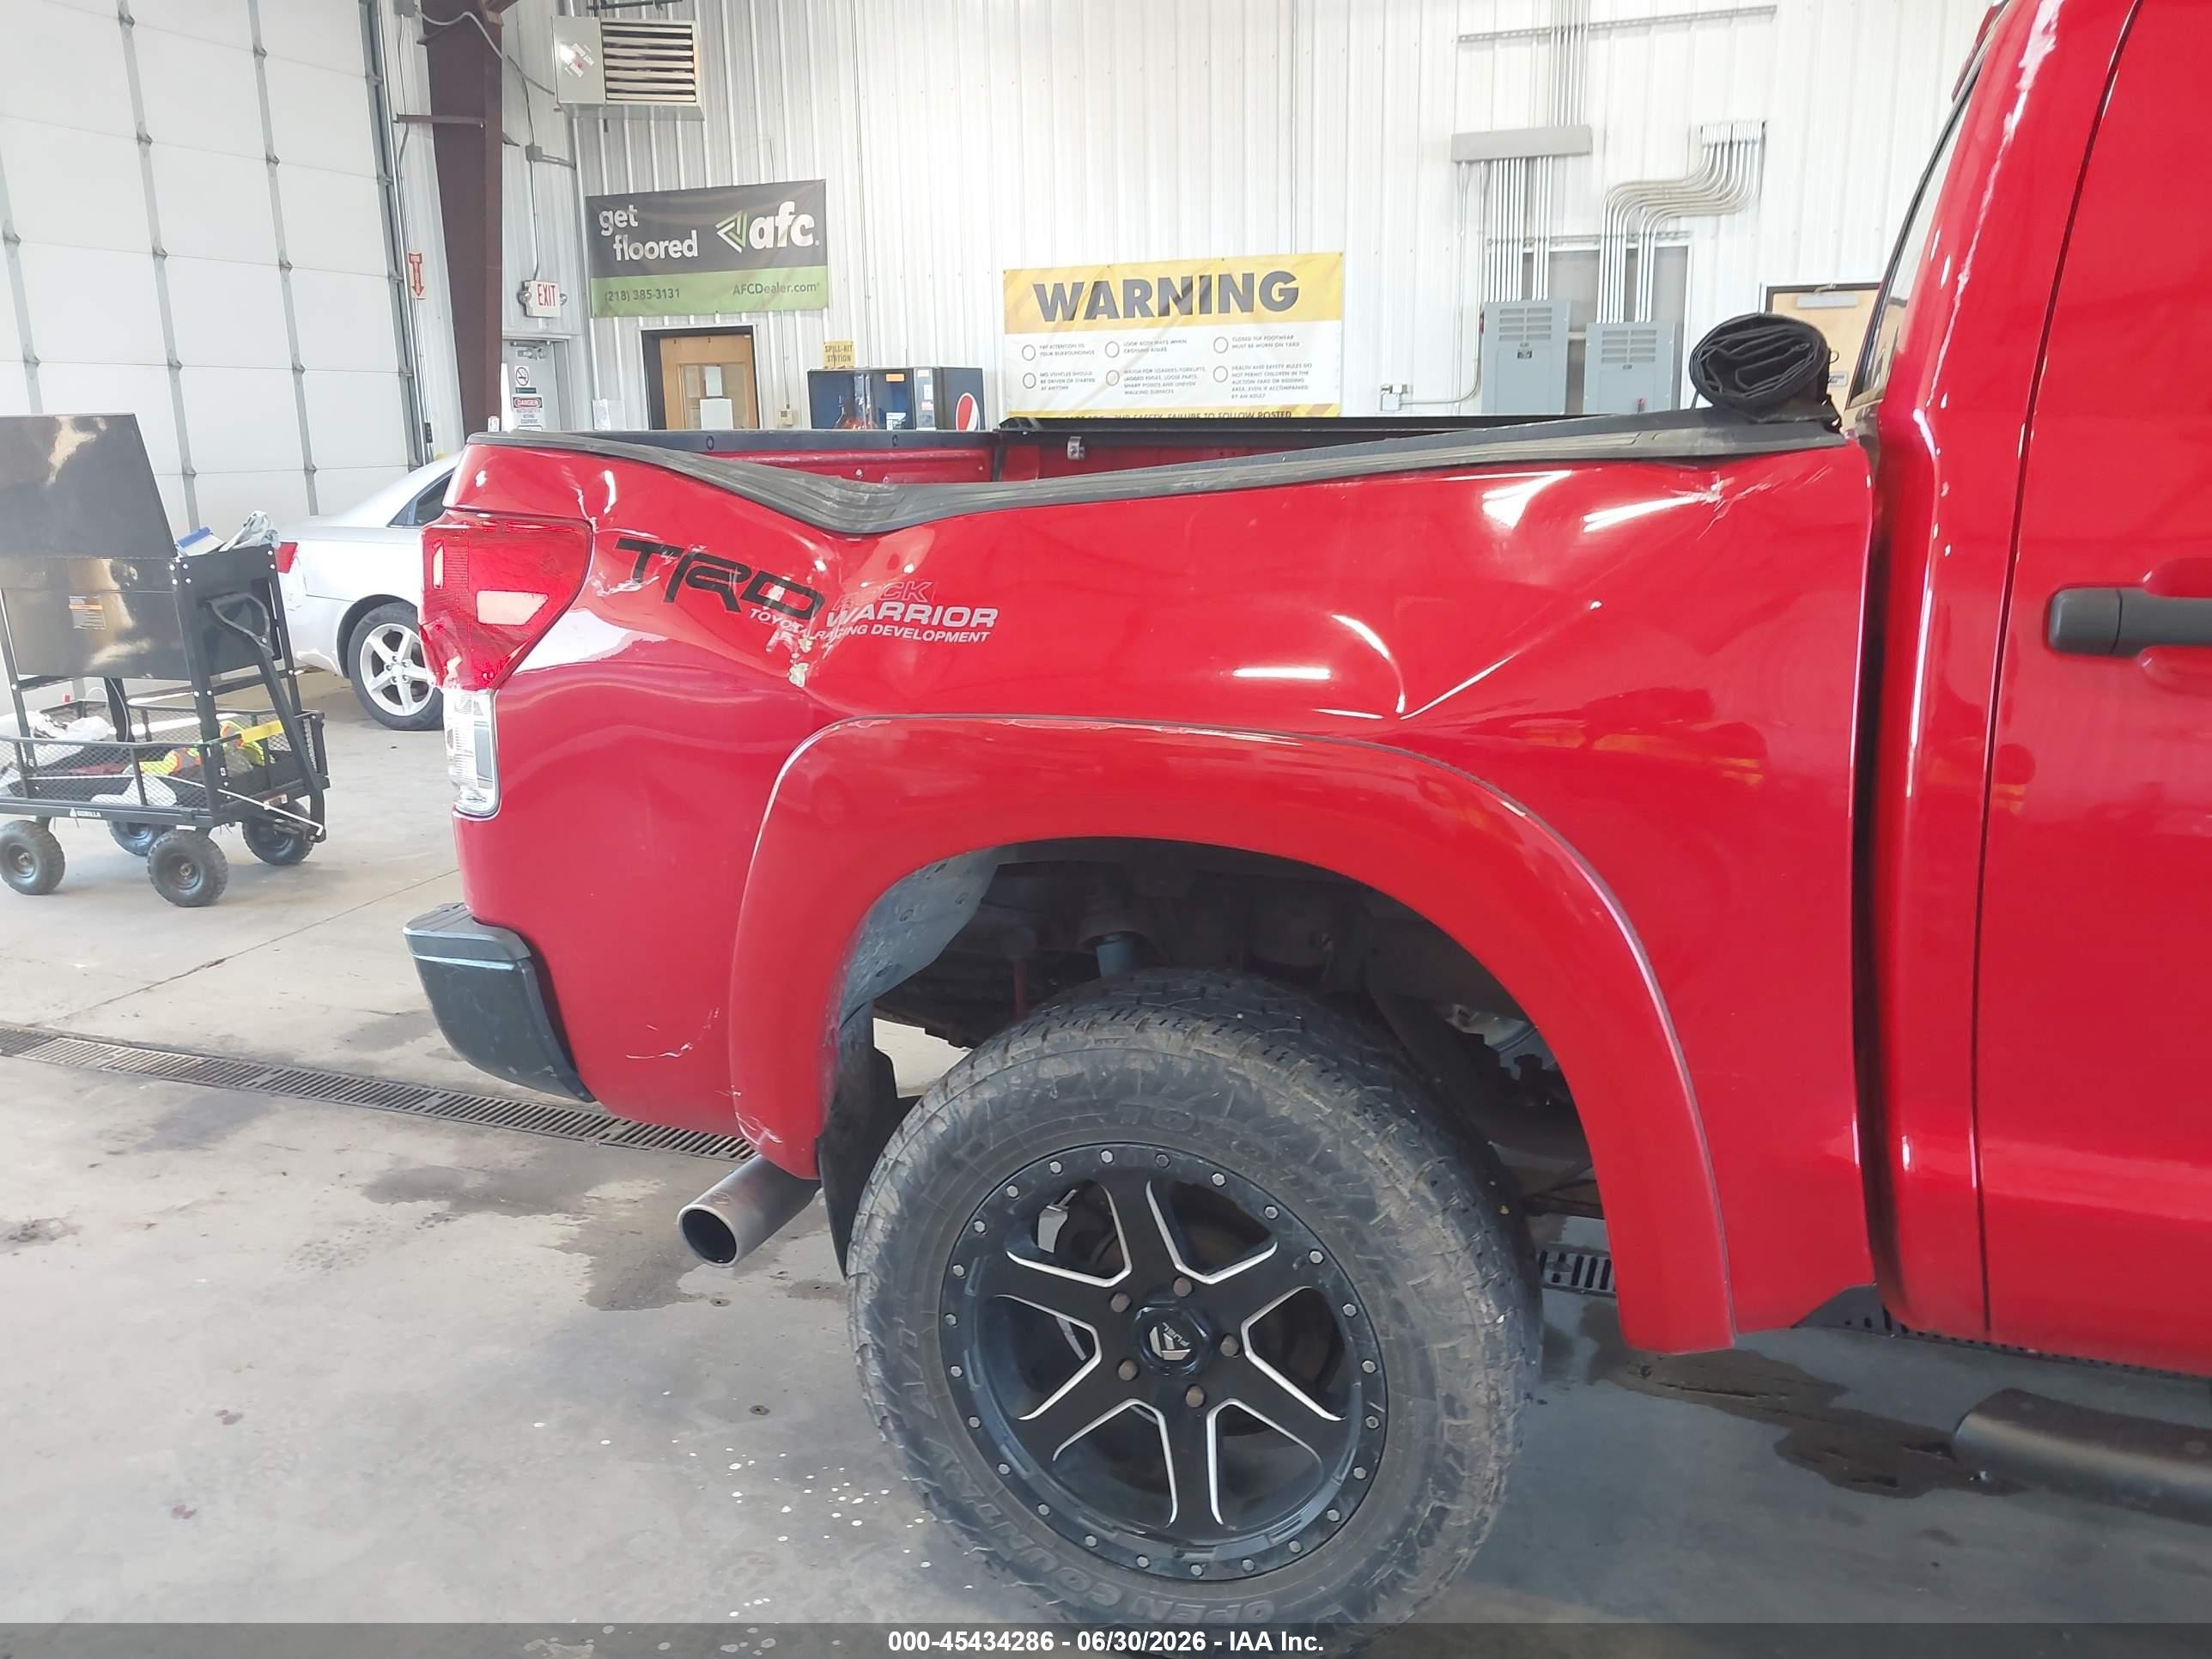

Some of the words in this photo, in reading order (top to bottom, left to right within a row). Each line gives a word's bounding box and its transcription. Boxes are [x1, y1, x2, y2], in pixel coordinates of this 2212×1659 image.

[599, 204, 638, 236] get
[613, 229, 699, 261] floored
[537, 283, 556, 307] EXIT
[605, 290, 629, 302] (218)
[632, 289, 680, 301] 385-3131
[732, 282, 817, 296] AFCDealer.com
[1033, 270, 1299, 322] WARNING
[824, 343, 853, 353] SPILL-KIT
[827, 354, 851, 363] STATION
[615, 538, 826, 620] TRD
[831, 580, 933, 611] RCK
[826, 601, 998, 628] WARRIOR
[870, 624, 990, 642] DEVELOPMENT
[1162, 1322, 1190, 1346] FUEL
